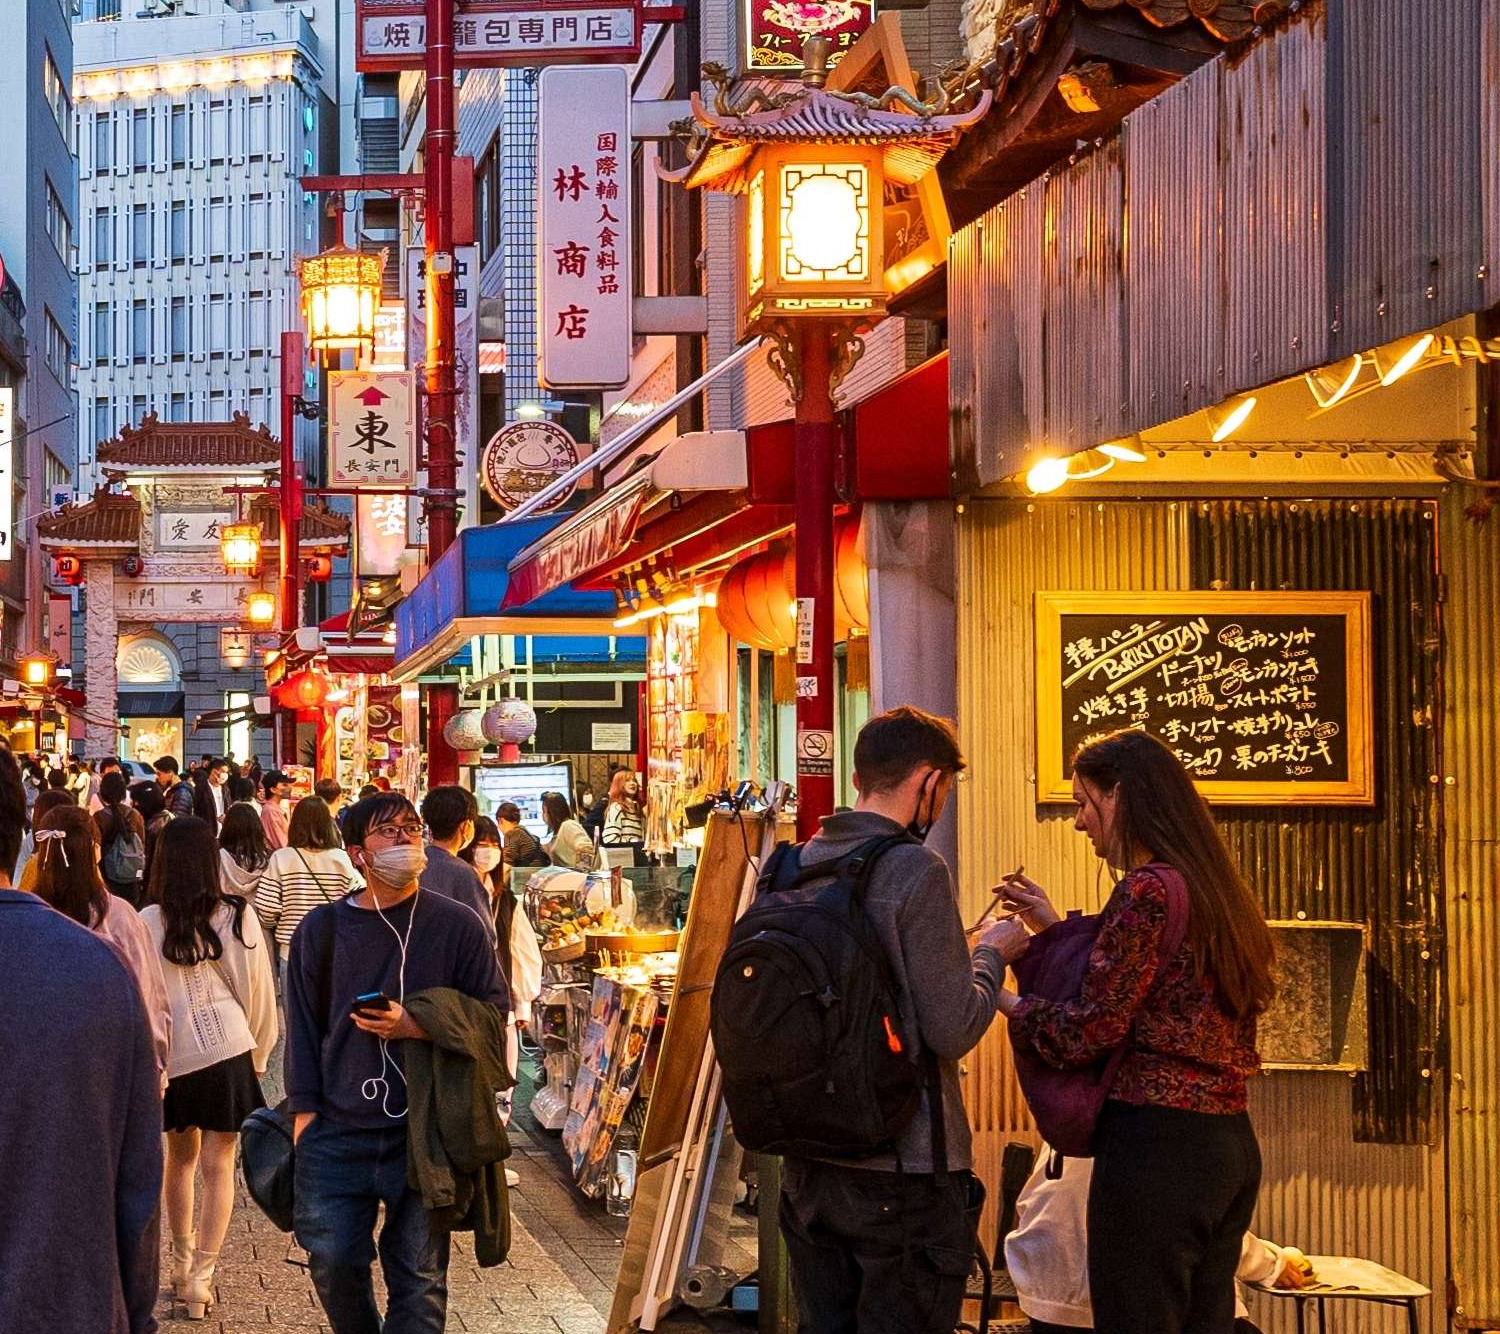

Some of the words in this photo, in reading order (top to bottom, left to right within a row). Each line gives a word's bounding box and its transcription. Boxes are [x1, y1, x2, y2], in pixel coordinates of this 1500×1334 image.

[383, 15, 612, 48] 焼籠包専門店
[759, 32, 859, 48] フィーフーヨン
[595, 132, 619, 295] 国際輸入食料品
[554, 164, 590, 340] 林商店
[348, 410, 397, 454] 東
[345, 458, 400, 473] 長安門
[1078, 685, 1149, 725] 焼き芋
